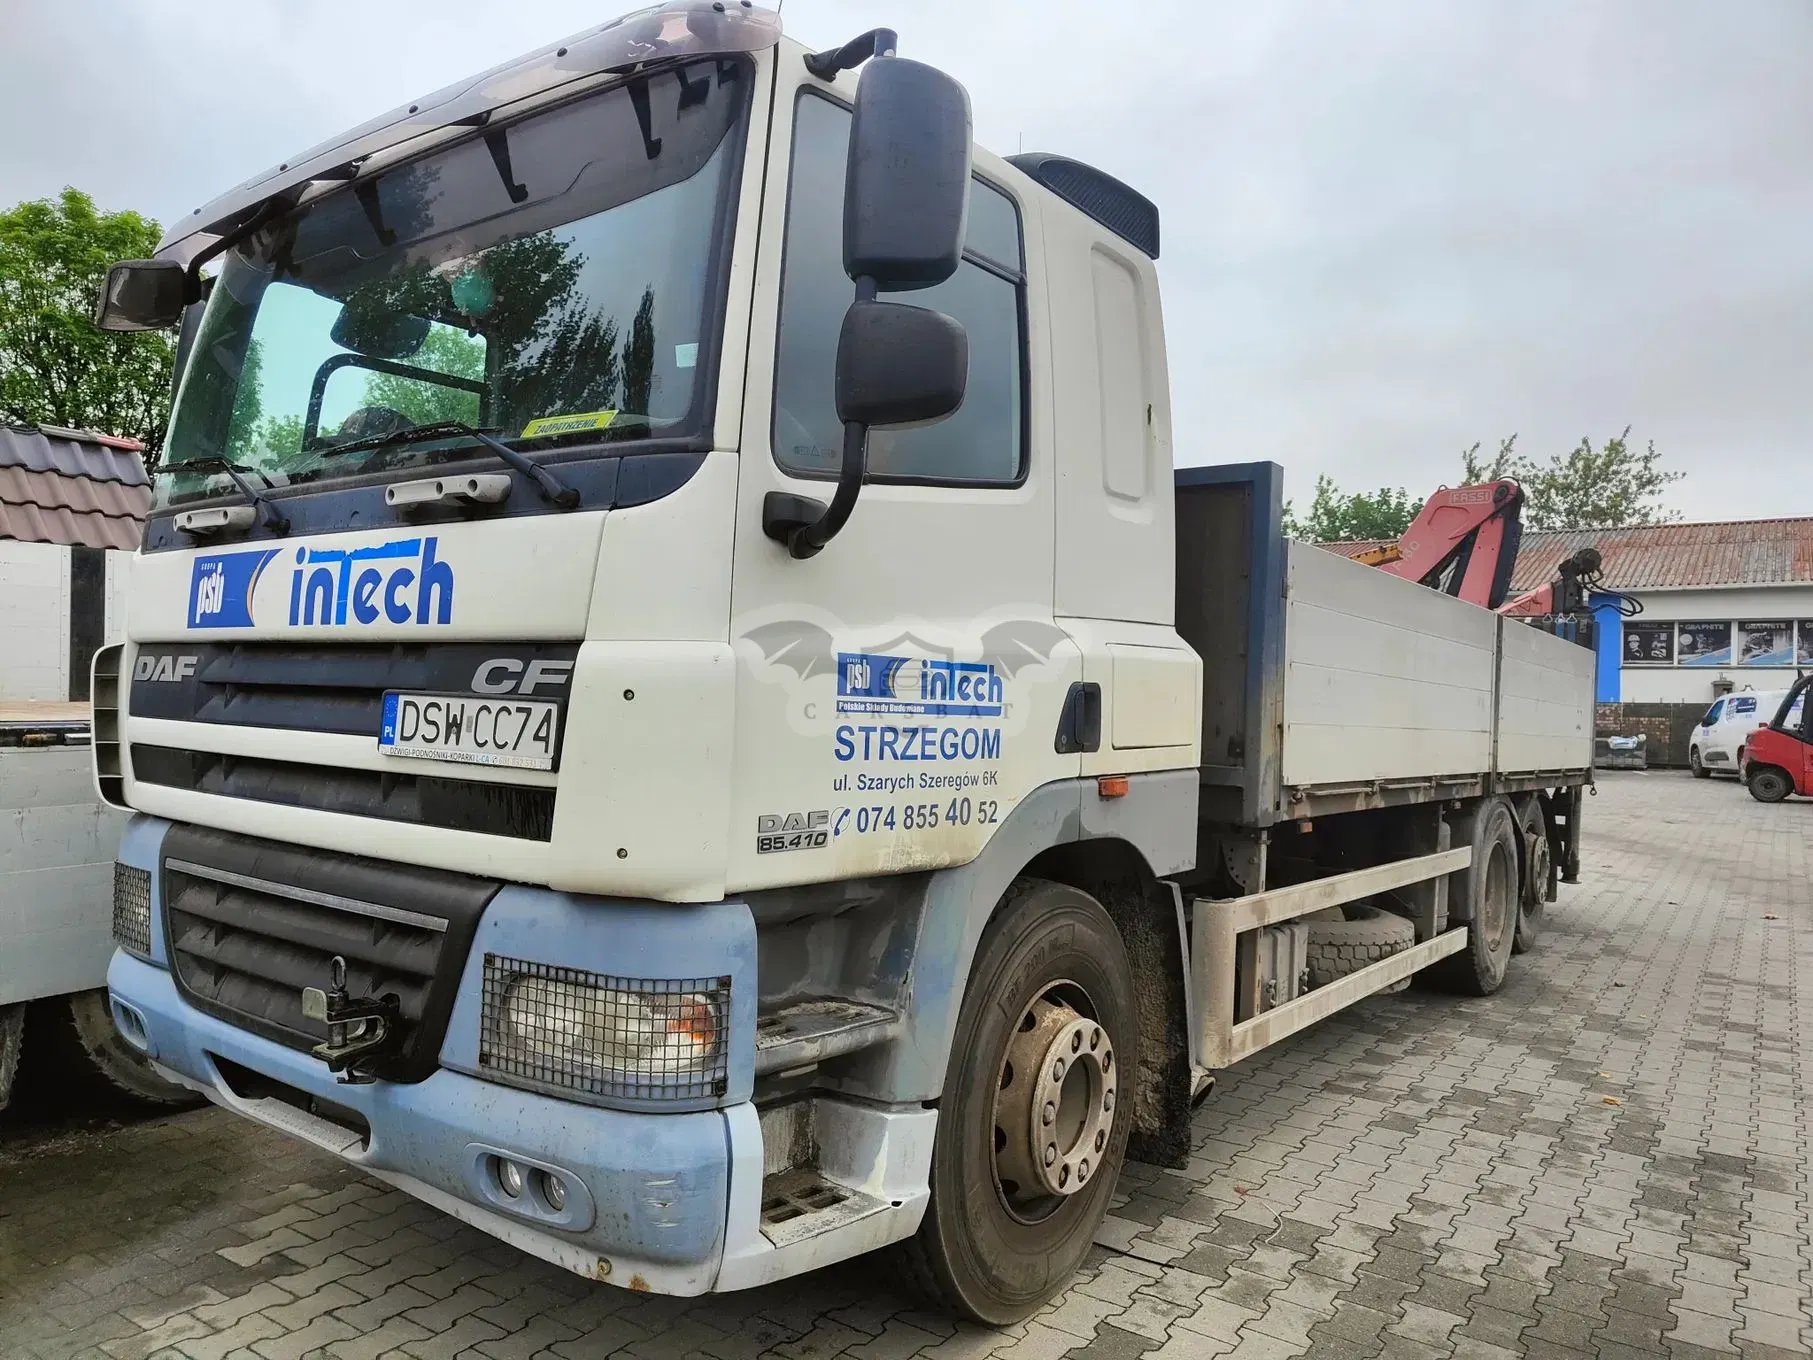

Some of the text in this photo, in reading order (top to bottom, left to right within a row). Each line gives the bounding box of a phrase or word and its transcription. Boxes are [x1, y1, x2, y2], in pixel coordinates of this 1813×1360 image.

[535, 418, 599, 434] ZAOPATRZENIE
[1453, 491, 1491, 503] FASSI
[195, 561, 225, 624] psb
[289, 537, 454, 626] inTech
[134, 655, 199, 682] DAF
[471, 658, 574, 695] CF
[846, 659, 871, 693] psb
[920, 658, 1003, 702] inTech
[838, 702, 864, 712] Polskie
[384, 726, 394, 737] PL
[474, 704, 552, 753] CC74
[834, 725, 1001, 761] STRZEGOM
[833, 770, 998, 793] ul. Szarych Szeregów 6K
[758, 810, 829, 833] DAF
[857, 797, 998, 833] 074 855 40 52
[758, 832, 828, 852] 85.410
